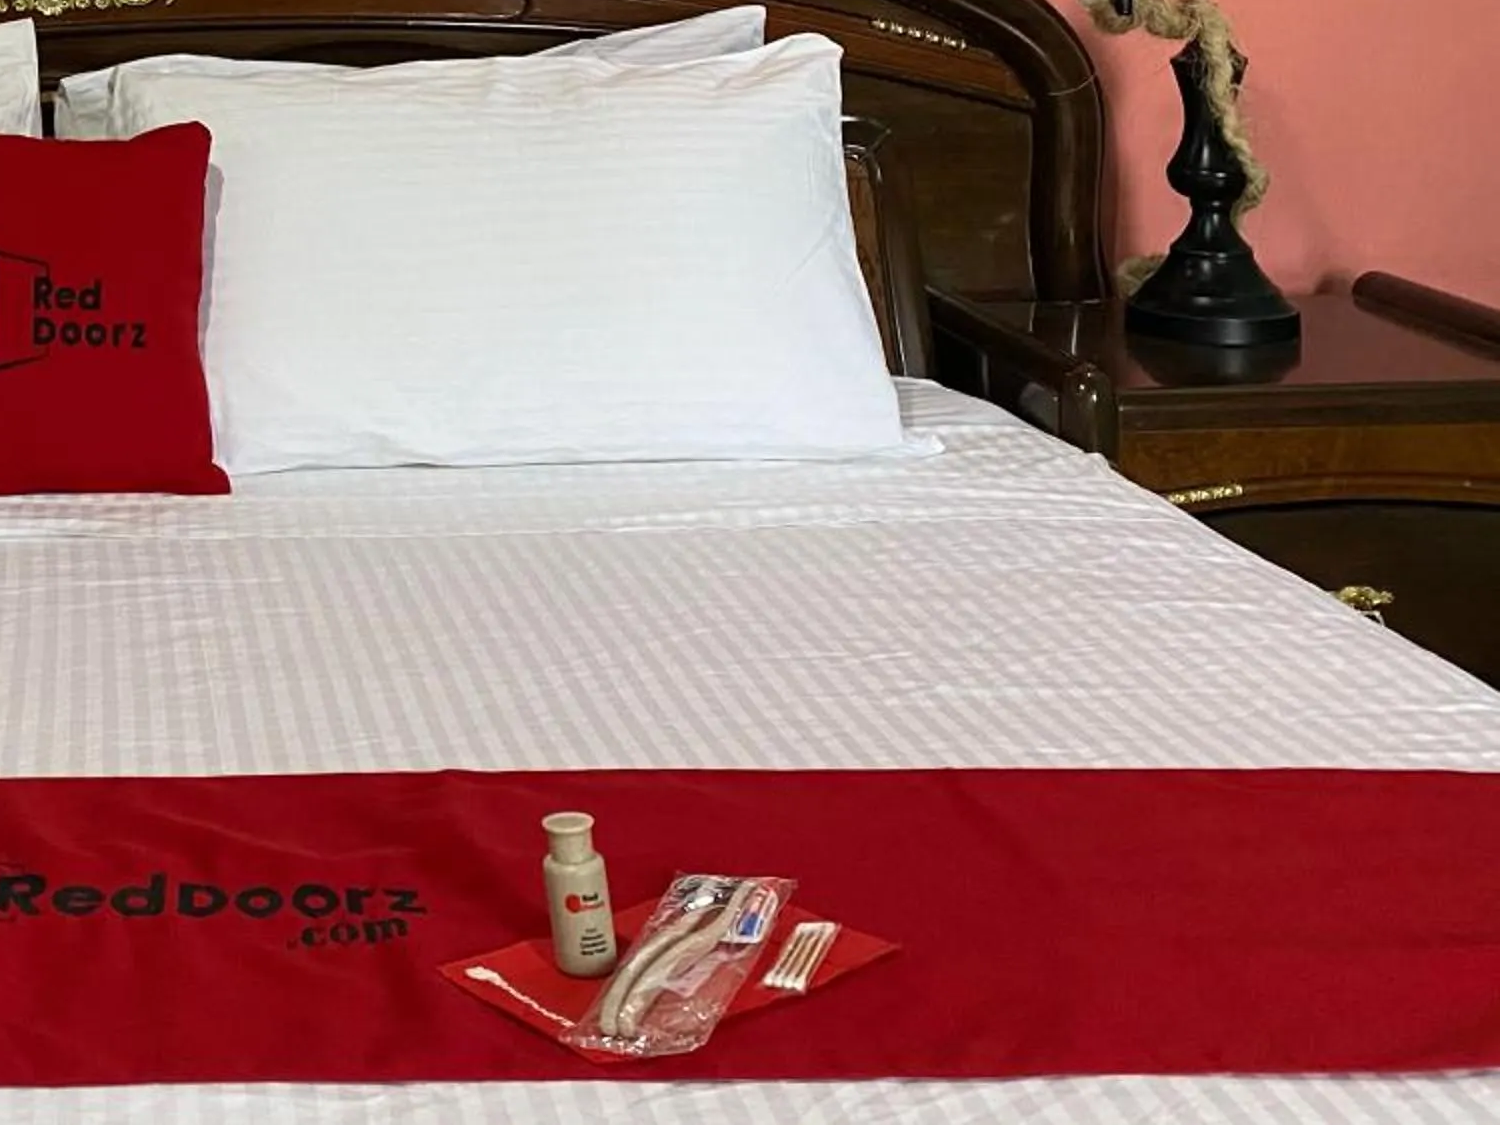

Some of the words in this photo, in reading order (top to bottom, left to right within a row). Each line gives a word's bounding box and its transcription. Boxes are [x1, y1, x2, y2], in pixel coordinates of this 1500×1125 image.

[33, 276, 102, 310] Red
[33, 317, 147, 348] Doorz
[287, 917, 409, 951] .com
